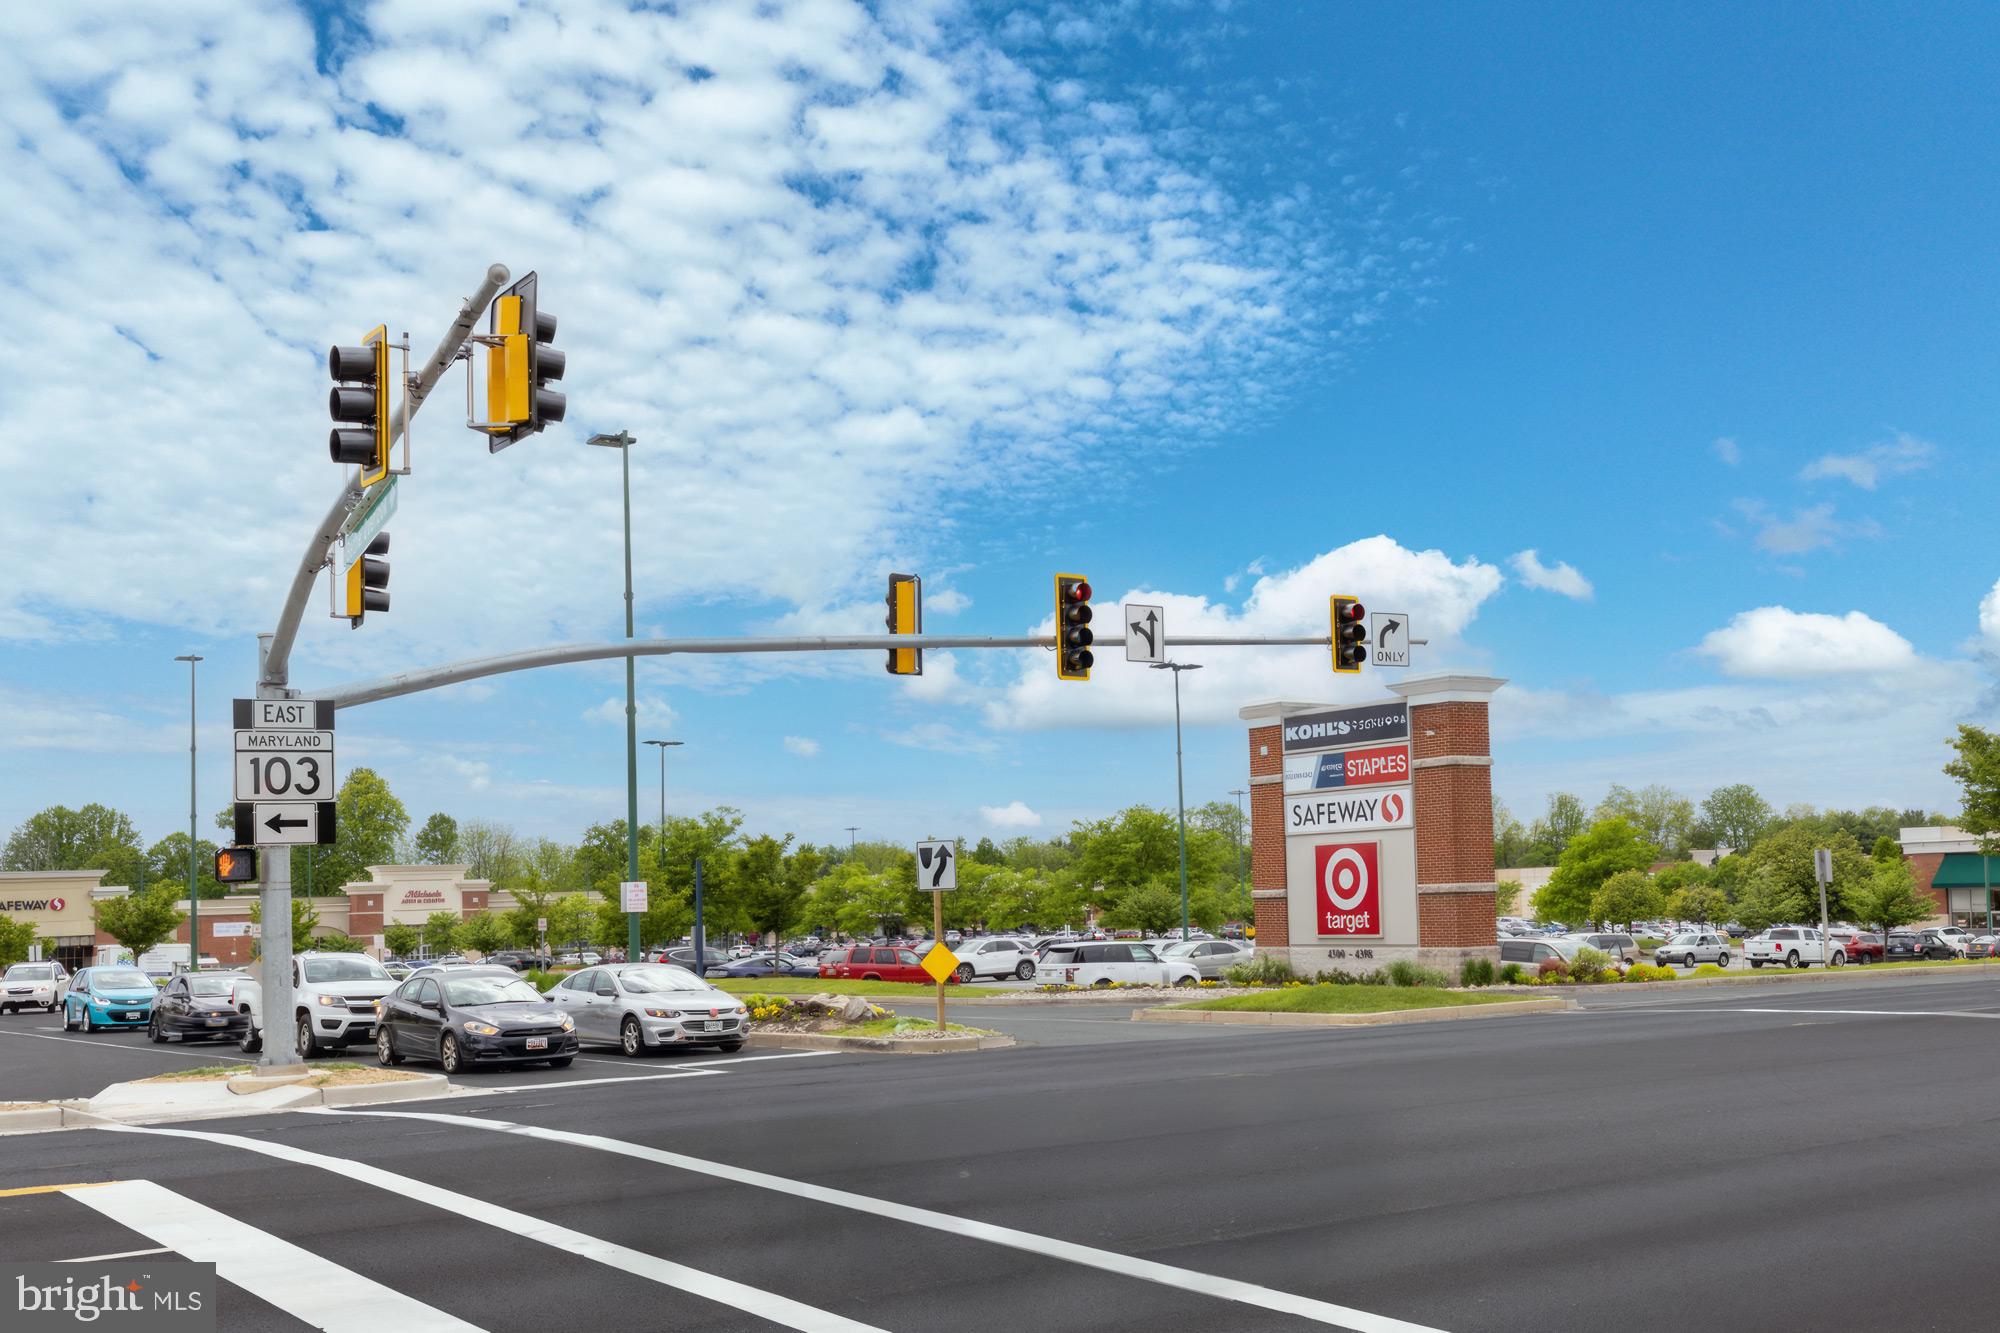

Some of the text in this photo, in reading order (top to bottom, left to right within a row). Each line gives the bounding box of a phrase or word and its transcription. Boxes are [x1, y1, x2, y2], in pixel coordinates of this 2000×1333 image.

[1377, 651, 1404, 662] ONLY
[264, 703, 305, 724] EAST
[248, 735, 321, 747] MARYLAND
[1285, 720, 1351, 741] KOHL'S
[249, 756, 320, 796] 103
[1347, 754, 1406, 778] STAPLES
[1293, 798, 1378, 827] SAFEWAY
[1325, 911, 1370, 933] target
